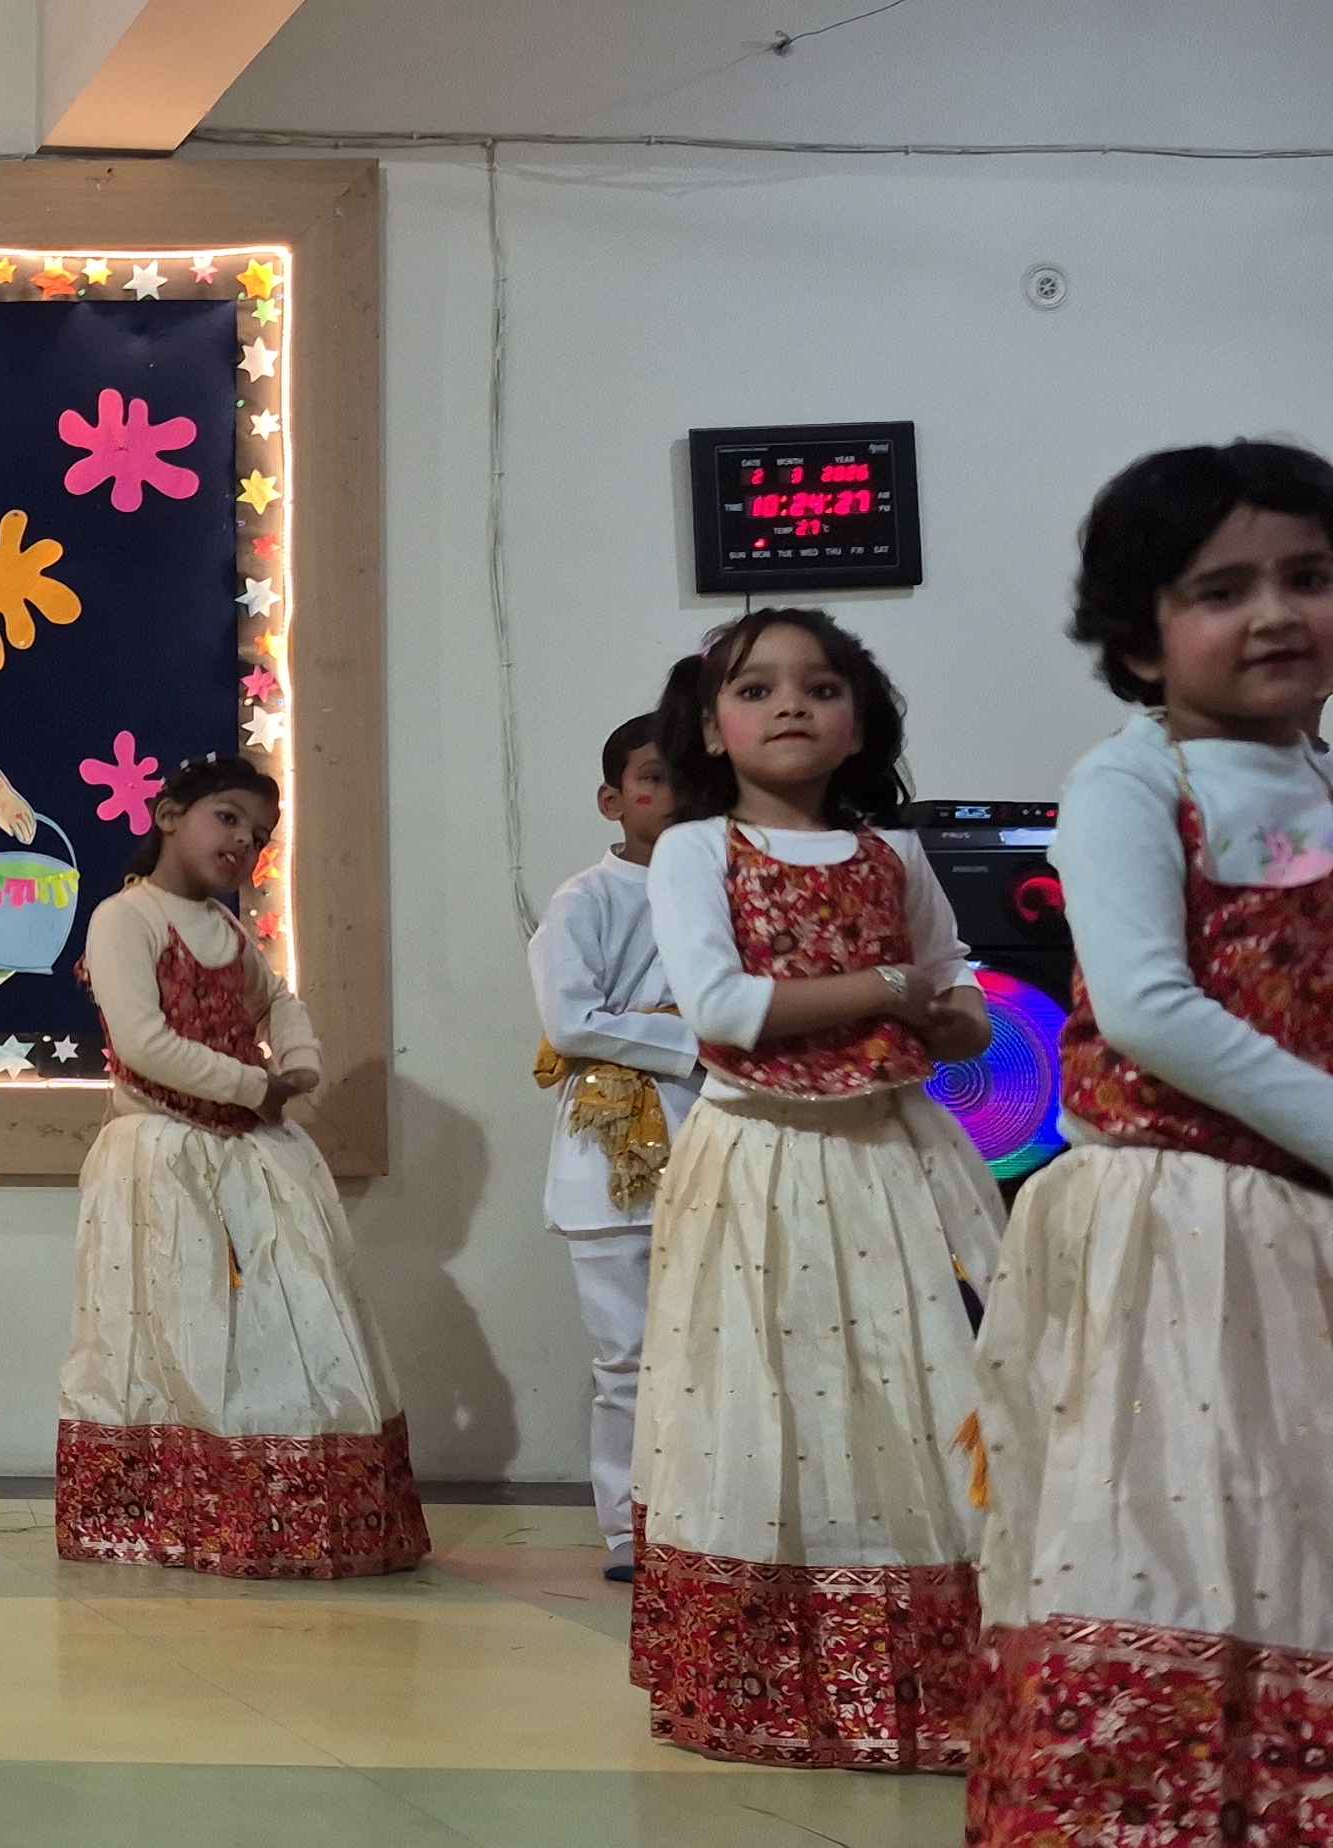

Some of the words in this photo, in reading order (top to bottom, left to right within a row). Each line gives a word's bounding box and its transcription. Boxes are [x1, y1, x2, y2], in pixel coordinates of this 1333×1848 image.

[834, 455, 856, 464] YEAR
[751, 468, 765, 485] 2
[790, 466, 804, 484] 3
[773, 526, 793, 535] TEMP
[825, 547, 843, 556] THU
